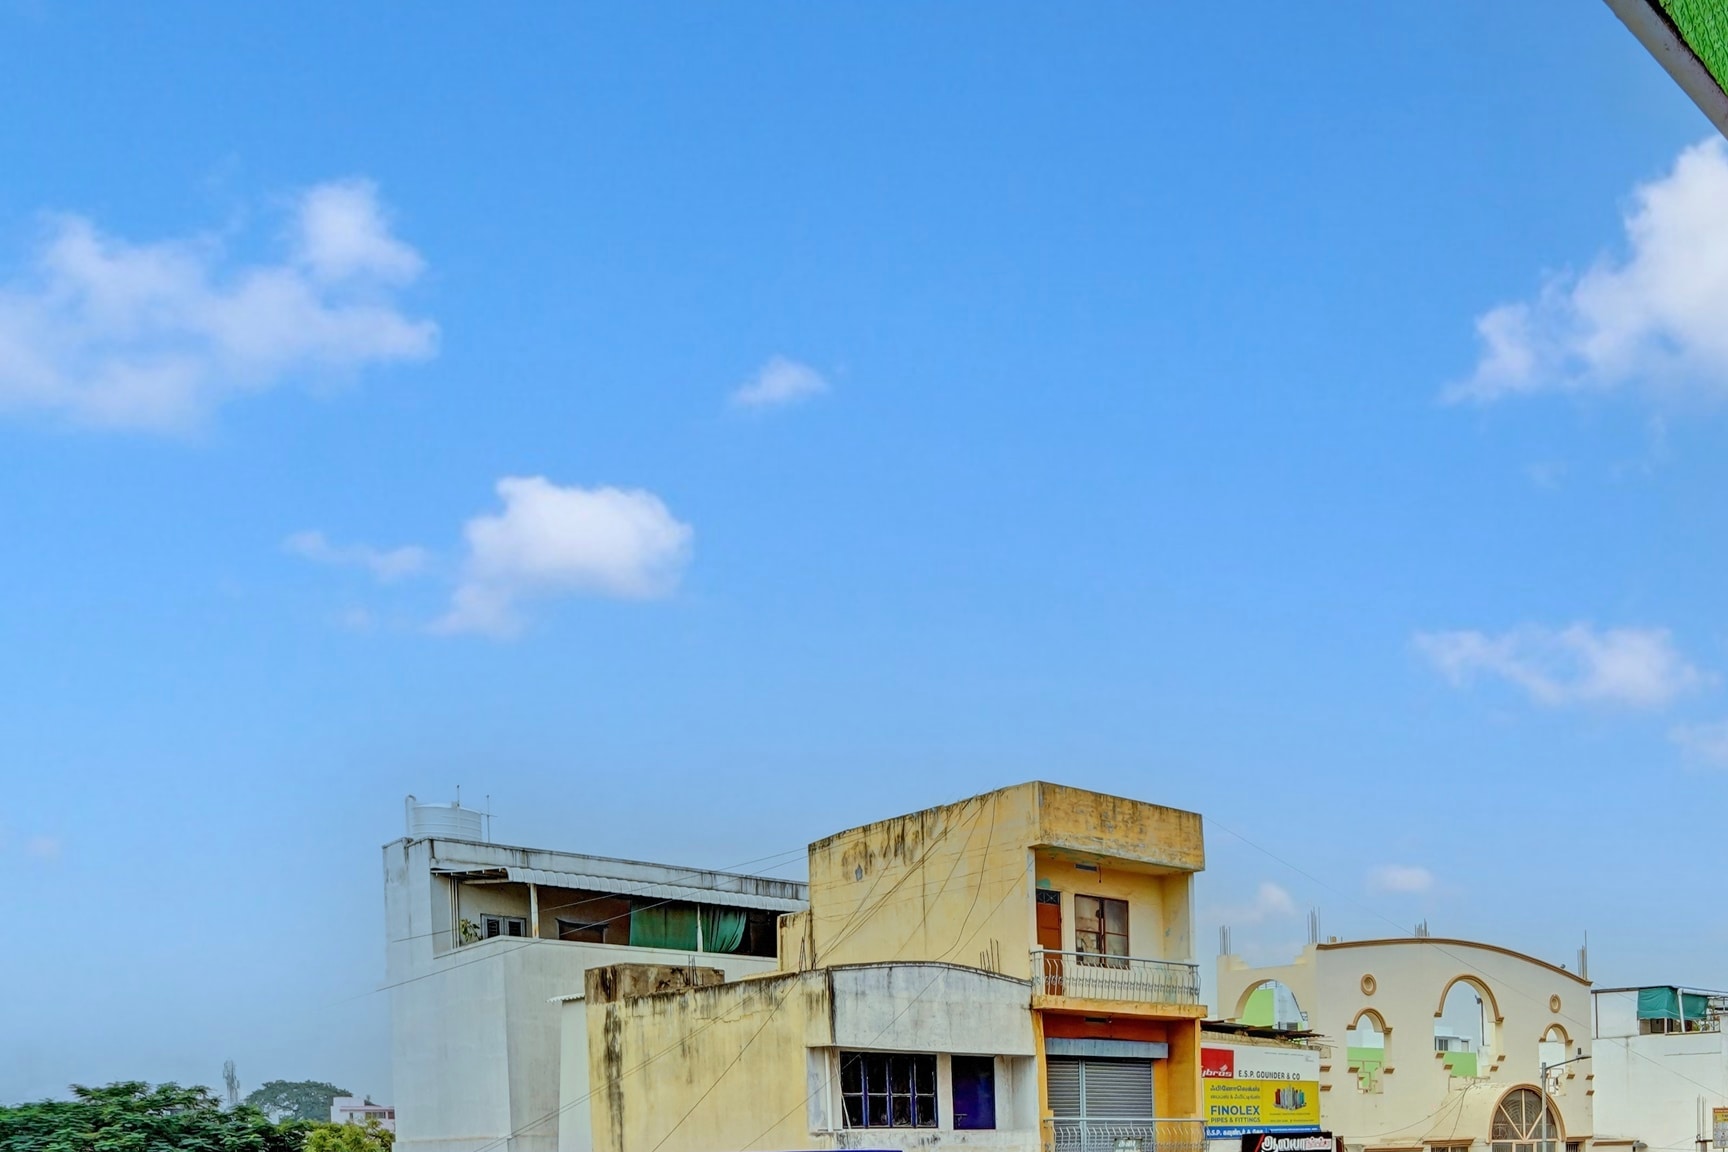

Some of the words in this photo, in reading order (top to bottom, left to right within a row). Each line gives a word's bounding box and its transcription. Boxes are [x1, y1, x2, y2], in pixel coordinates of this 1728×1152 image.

[1256, 1071, 1285, 1080] GOUNDER
[1292, 1073, 1300, 1081] CO
[1210, 1105, 1261, 1116] FINOLEX
